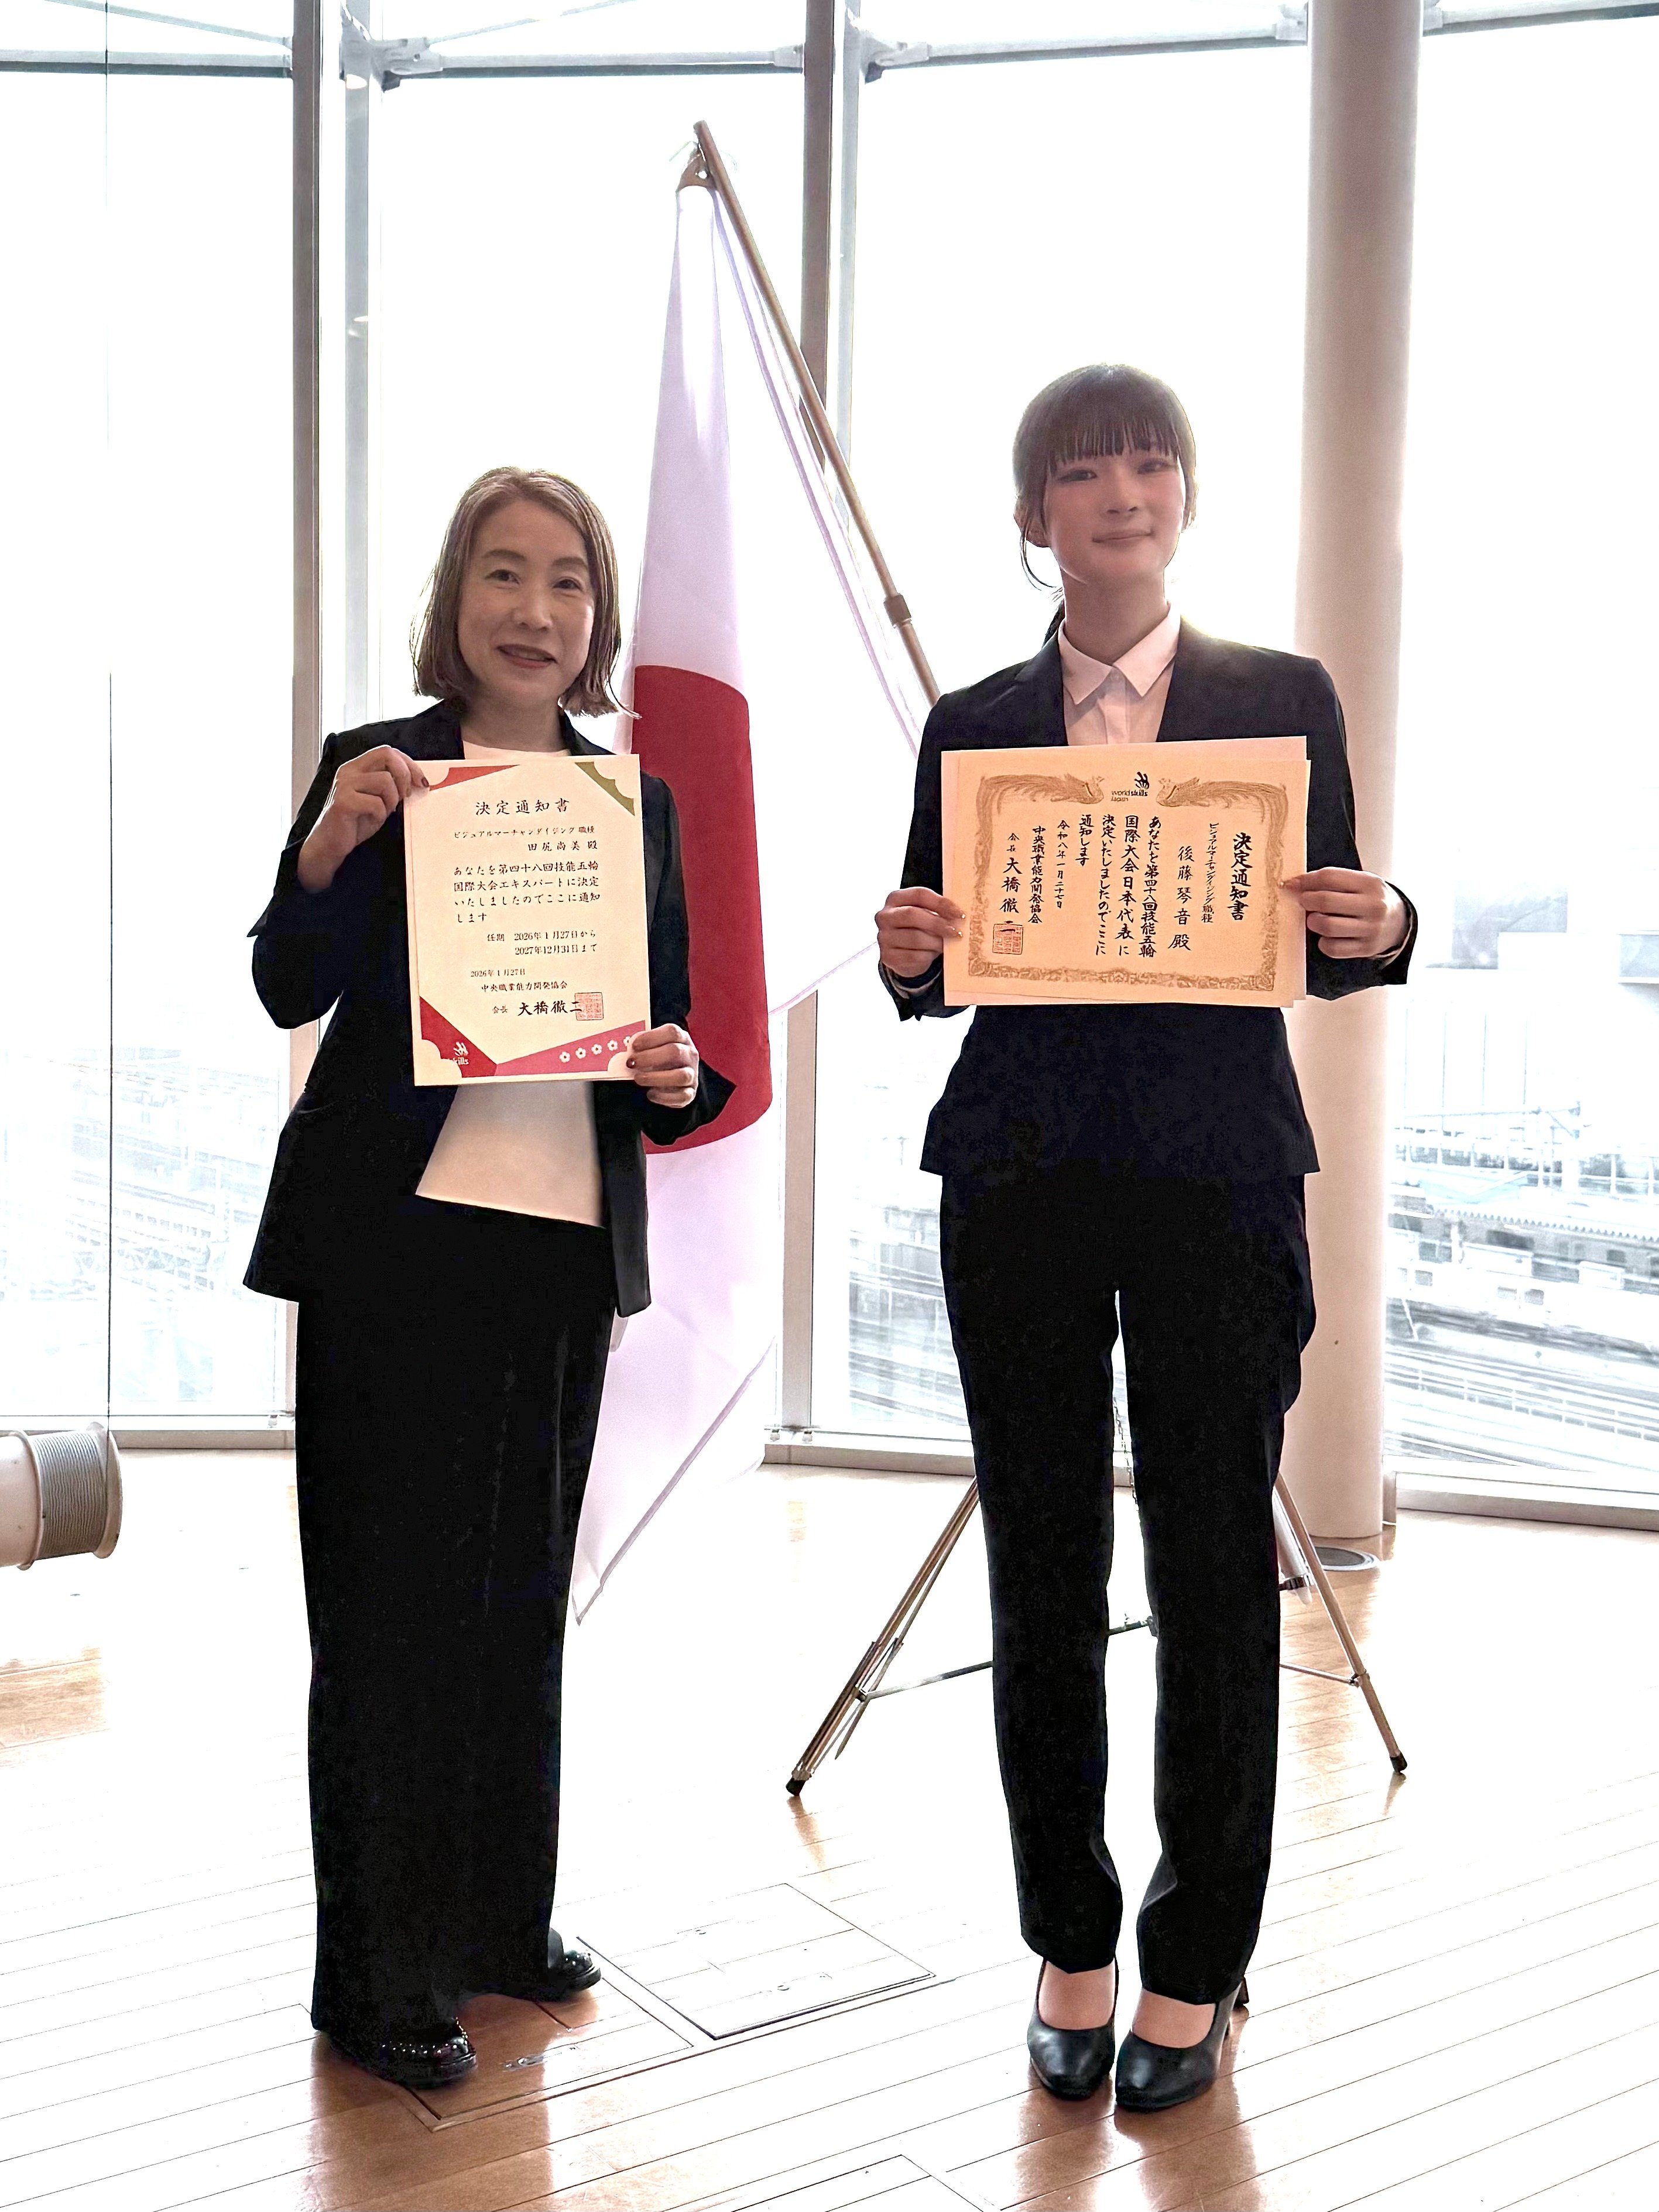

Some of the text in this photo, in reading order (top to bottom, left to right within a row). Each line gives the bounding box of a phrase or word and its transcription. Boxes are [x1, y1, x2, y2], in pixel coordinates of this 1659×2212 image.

[475, 797, 570, 815] 決定通知書
[1053, 819, 1071, 909] 令和八年一月二十七日
[1075, 814, 1095, 867] 通知します
[454, 861, 599, 876] あなたを第四十八回技能五輪
[454, 877, 599, 892] 国際大会エキスパートに決定
[1027, 825, 1047, 924] 中央職業能力開発協会
[1095, 814, 1116, 956] 決定いたしましたのでここに
[1115, 815, 1141, 955] 国際大会日本代表に
[1138, 815, 1161, 958] あなたを第四十八回技能五輪
[1226, 832, 1254, 921] 決定通知書
[457, 913, 487, 923] します
[487, 933, 505, 942] 任期
[481, 980, 567, 992] 中央職業能力開発協会
